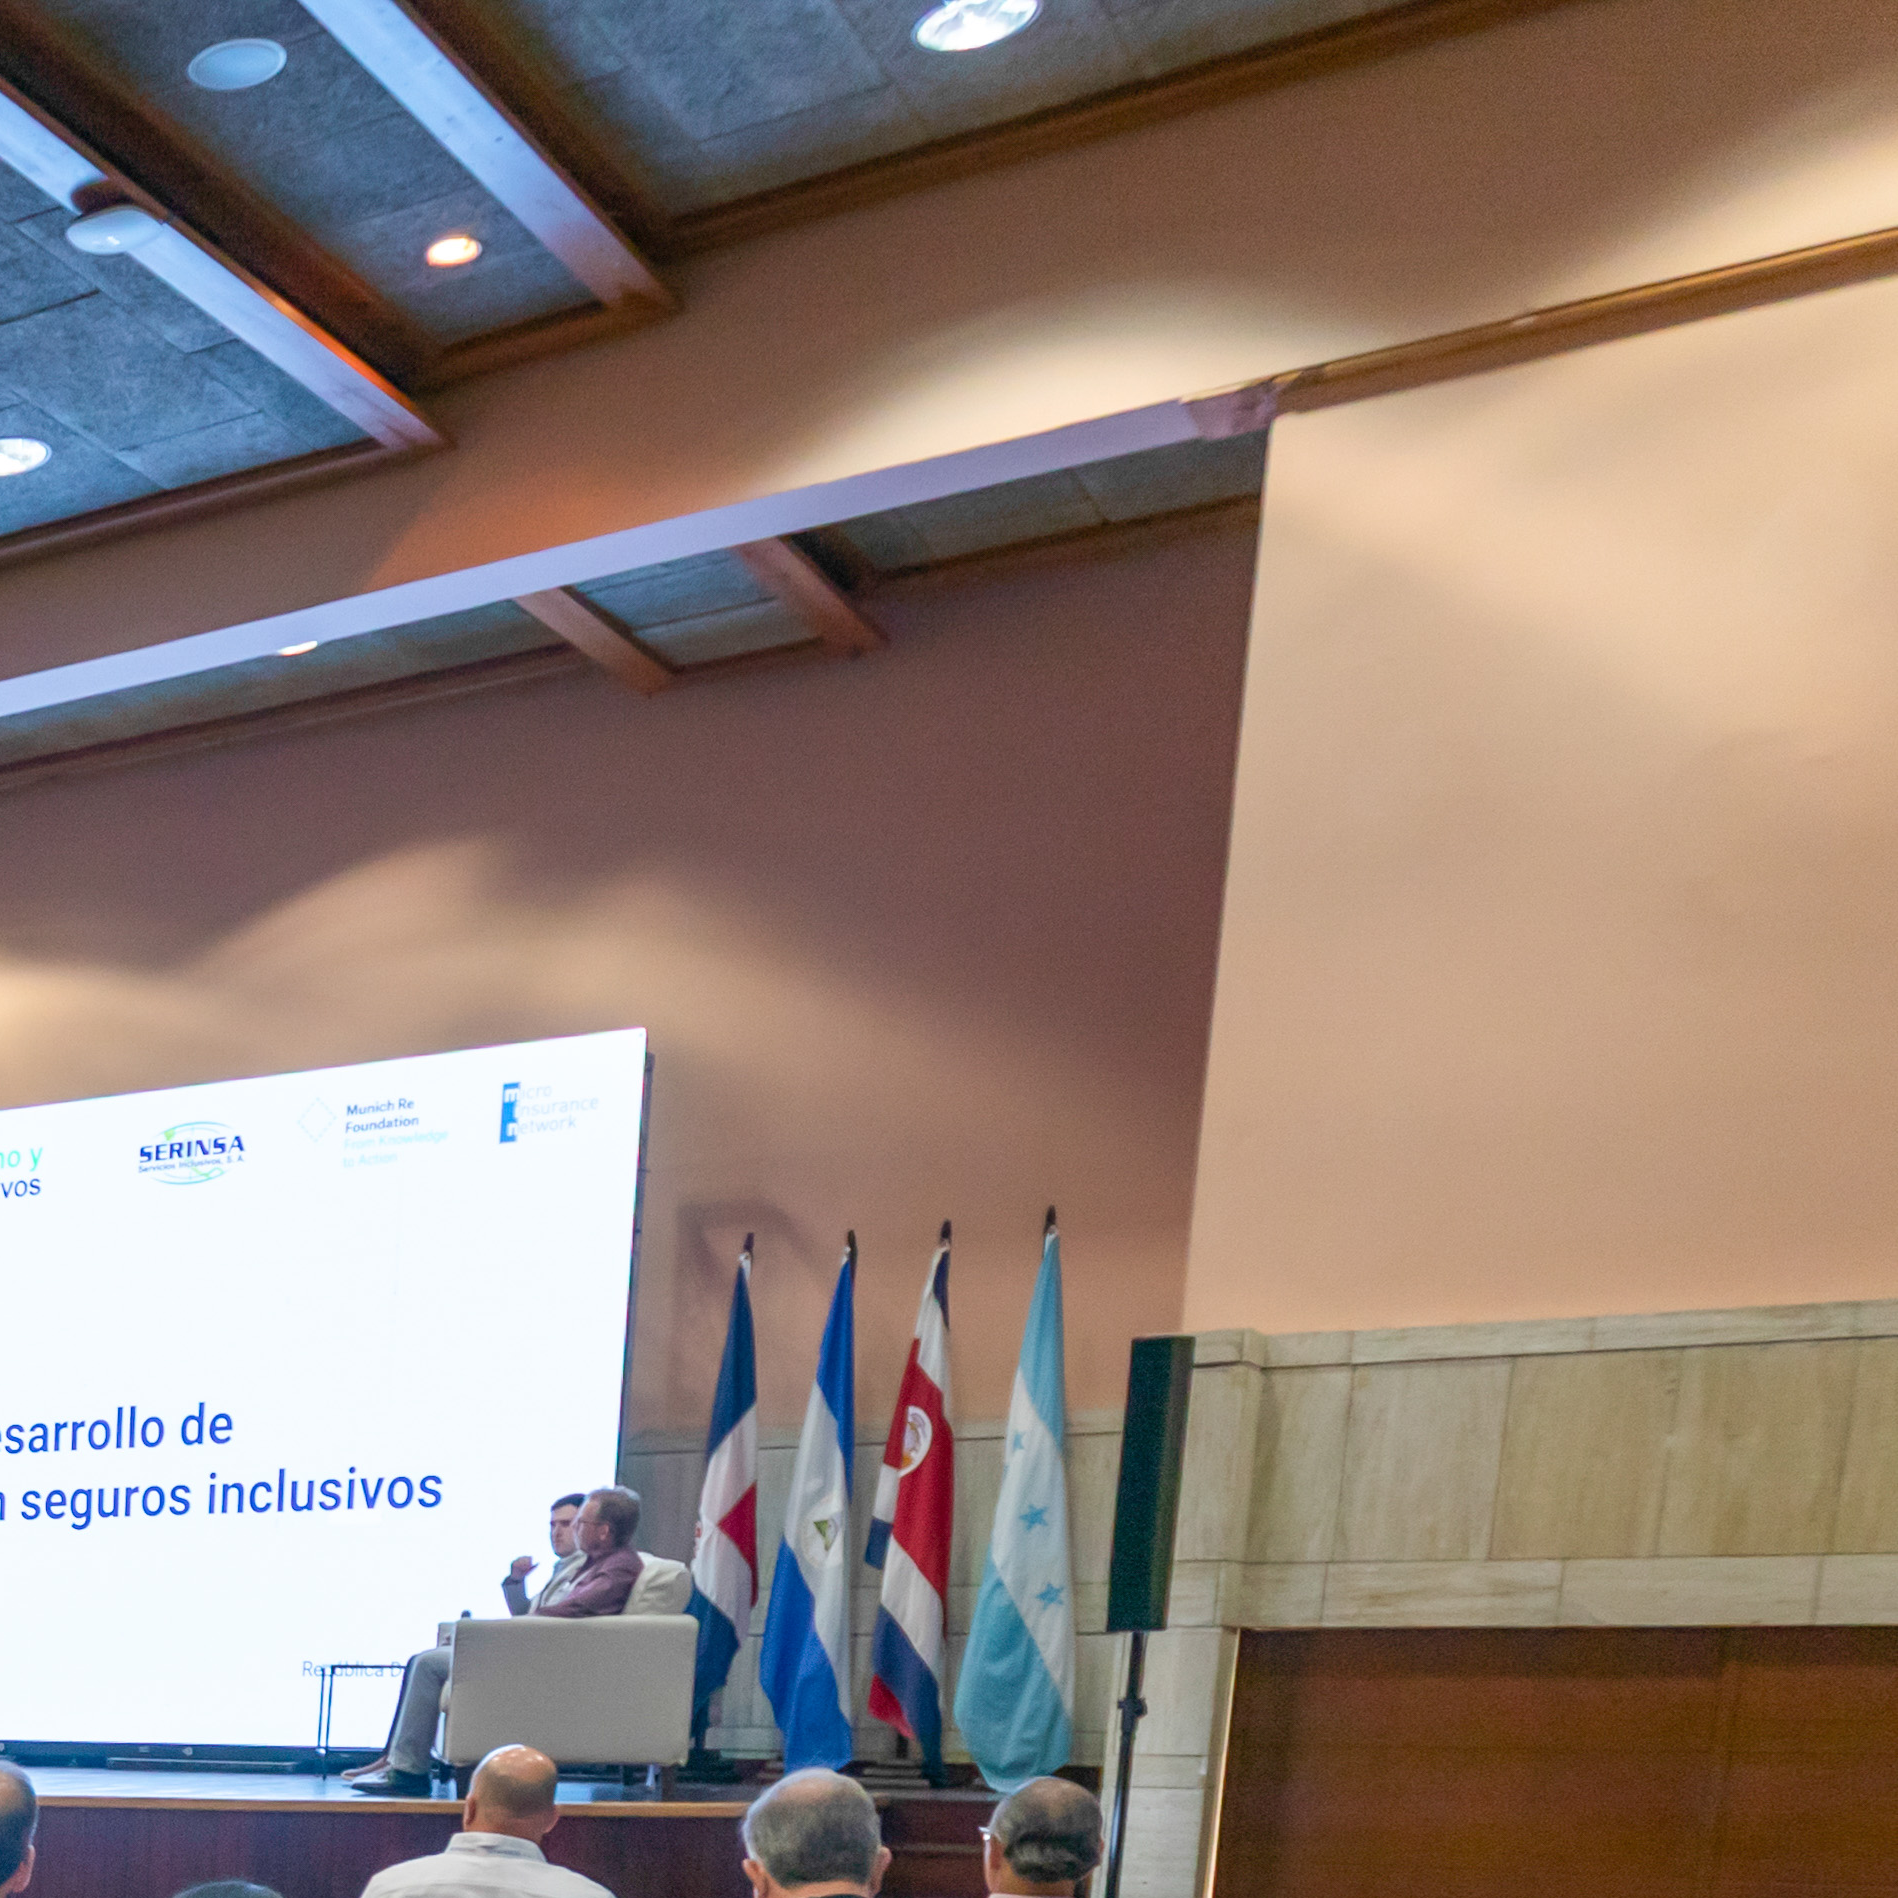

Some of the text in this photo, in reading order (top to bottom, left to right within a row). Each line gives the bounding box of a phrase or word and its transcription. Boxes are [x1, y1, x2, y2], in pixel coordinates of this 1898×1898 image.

[346, 1098, 415, 1116] Munich Re
[345, 1116, 420, 1133] Foundation
[29, 1147, 43, 1172] y
[139, 1135, 245, 1163] SERINSA
[180, 1401, 234, 1446] de
[20, 1485, 192, 1530] seguros
[208, 1466, 443, 1514] inclusivos
